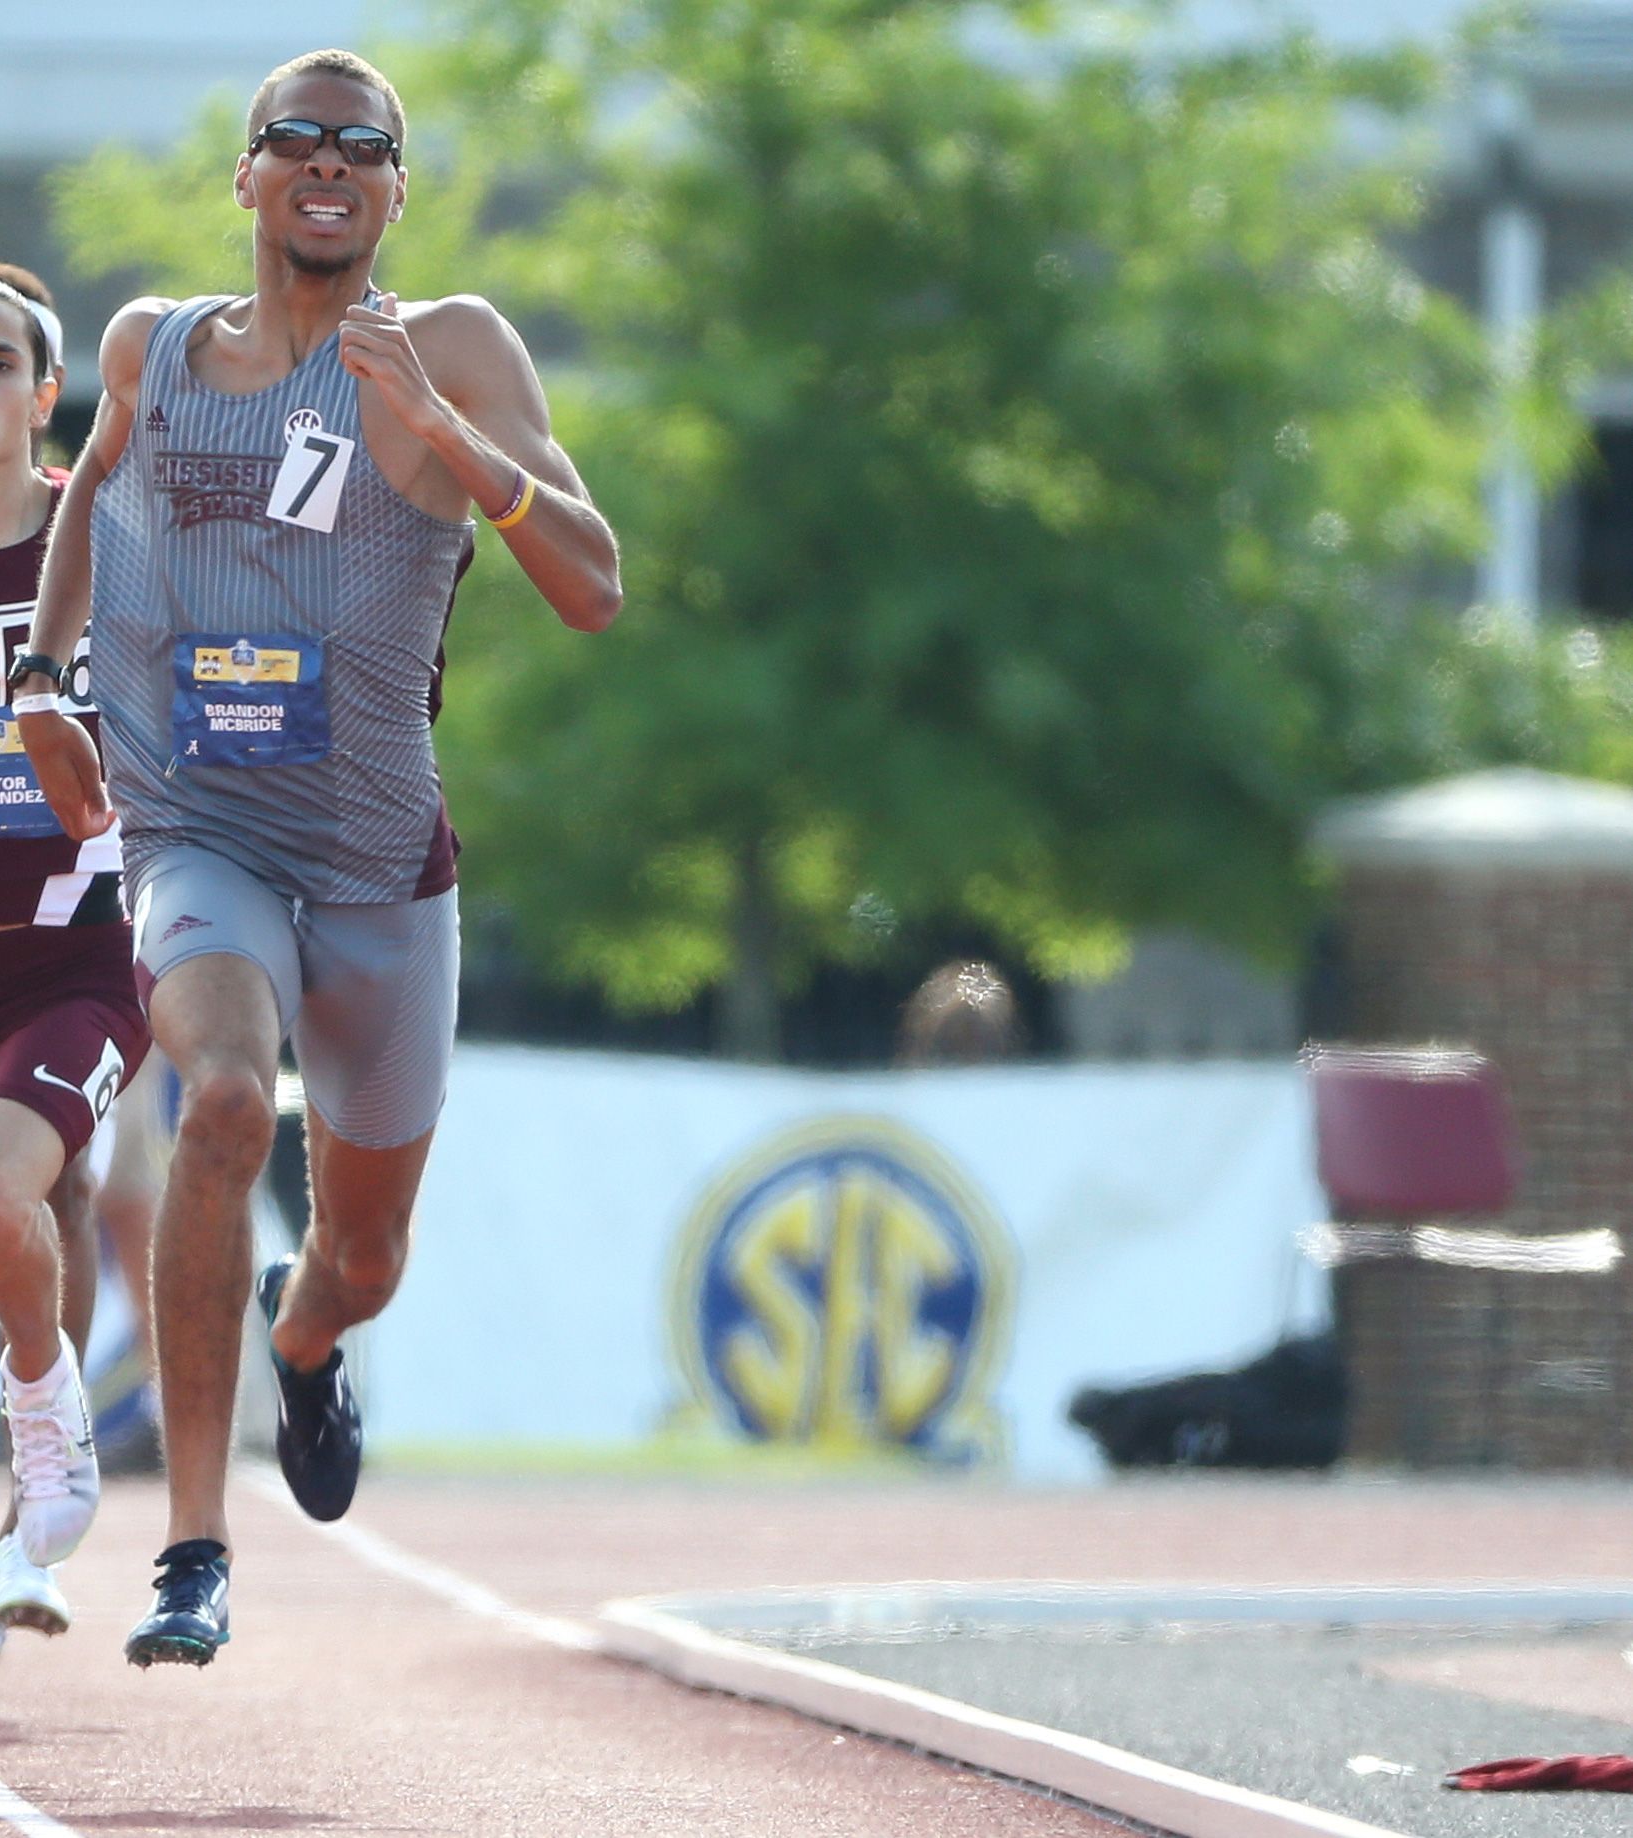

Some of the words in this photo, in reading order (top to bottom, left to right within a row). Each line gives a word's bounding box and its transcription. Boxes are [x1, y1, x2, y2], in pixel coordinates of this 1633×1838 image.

[155, 458, 281, 489] MISSISSI
[285, 436, 340, 517] 7
[204, 704, 285, 718] BRANDON
[209, 718, 283, 732] MCBRIDE
